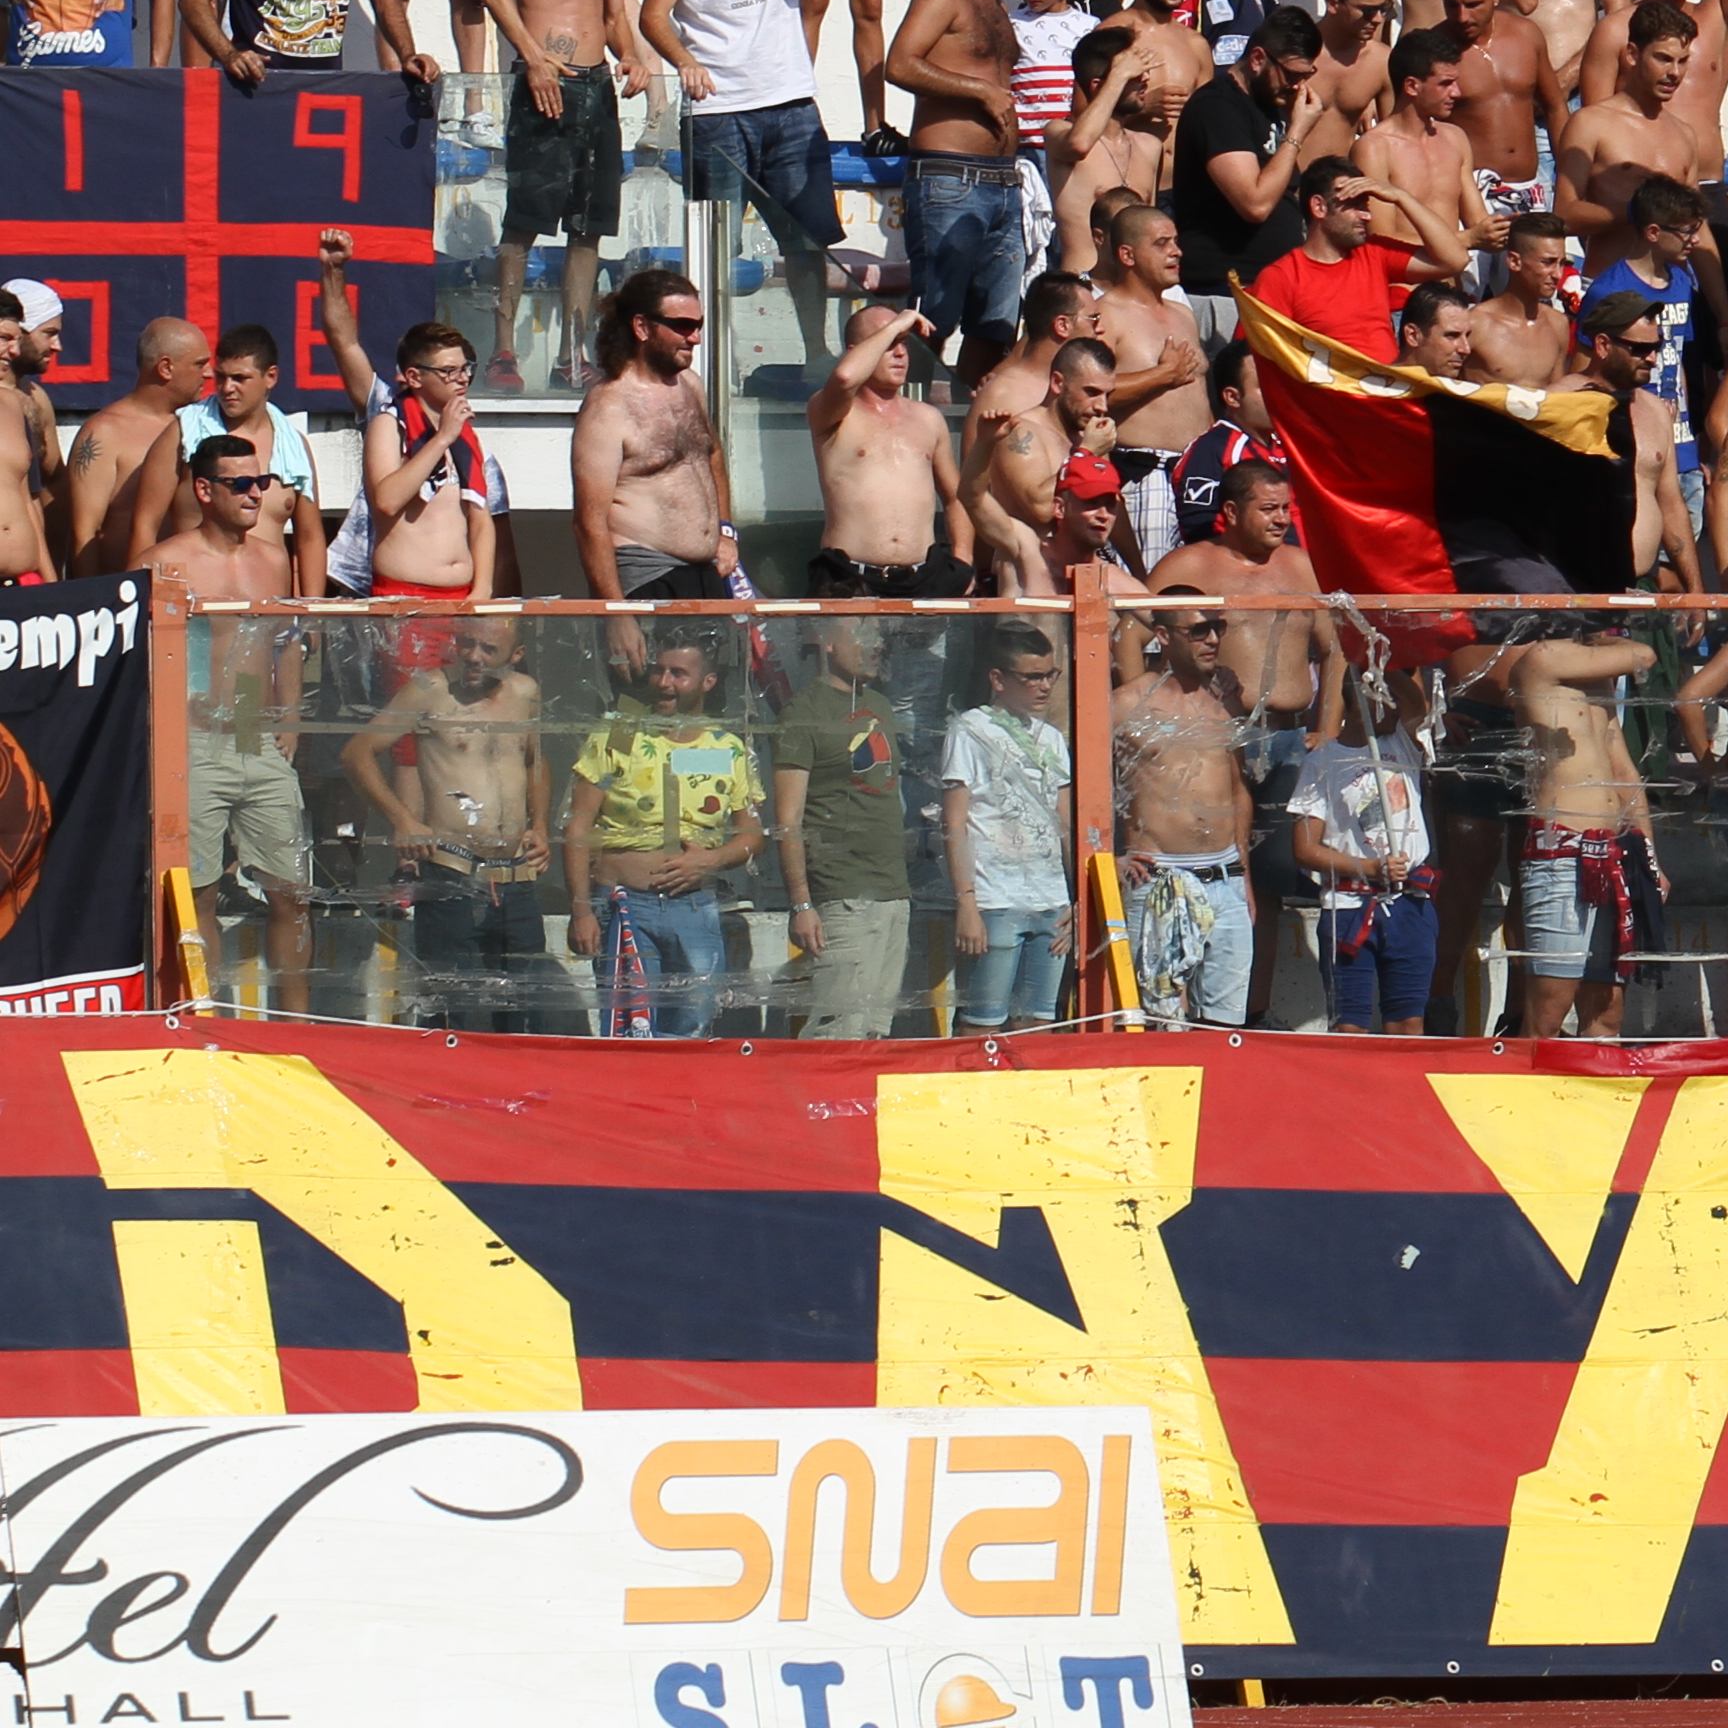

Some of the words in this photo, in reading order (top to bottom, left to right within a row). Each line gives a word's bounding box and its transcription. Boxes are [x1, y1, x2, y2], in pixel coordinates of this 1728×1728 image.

[17, 21, 106, 69] Games
[293, 91, 363, 204] 9
[13, 1689, 291, 1725] HALL
